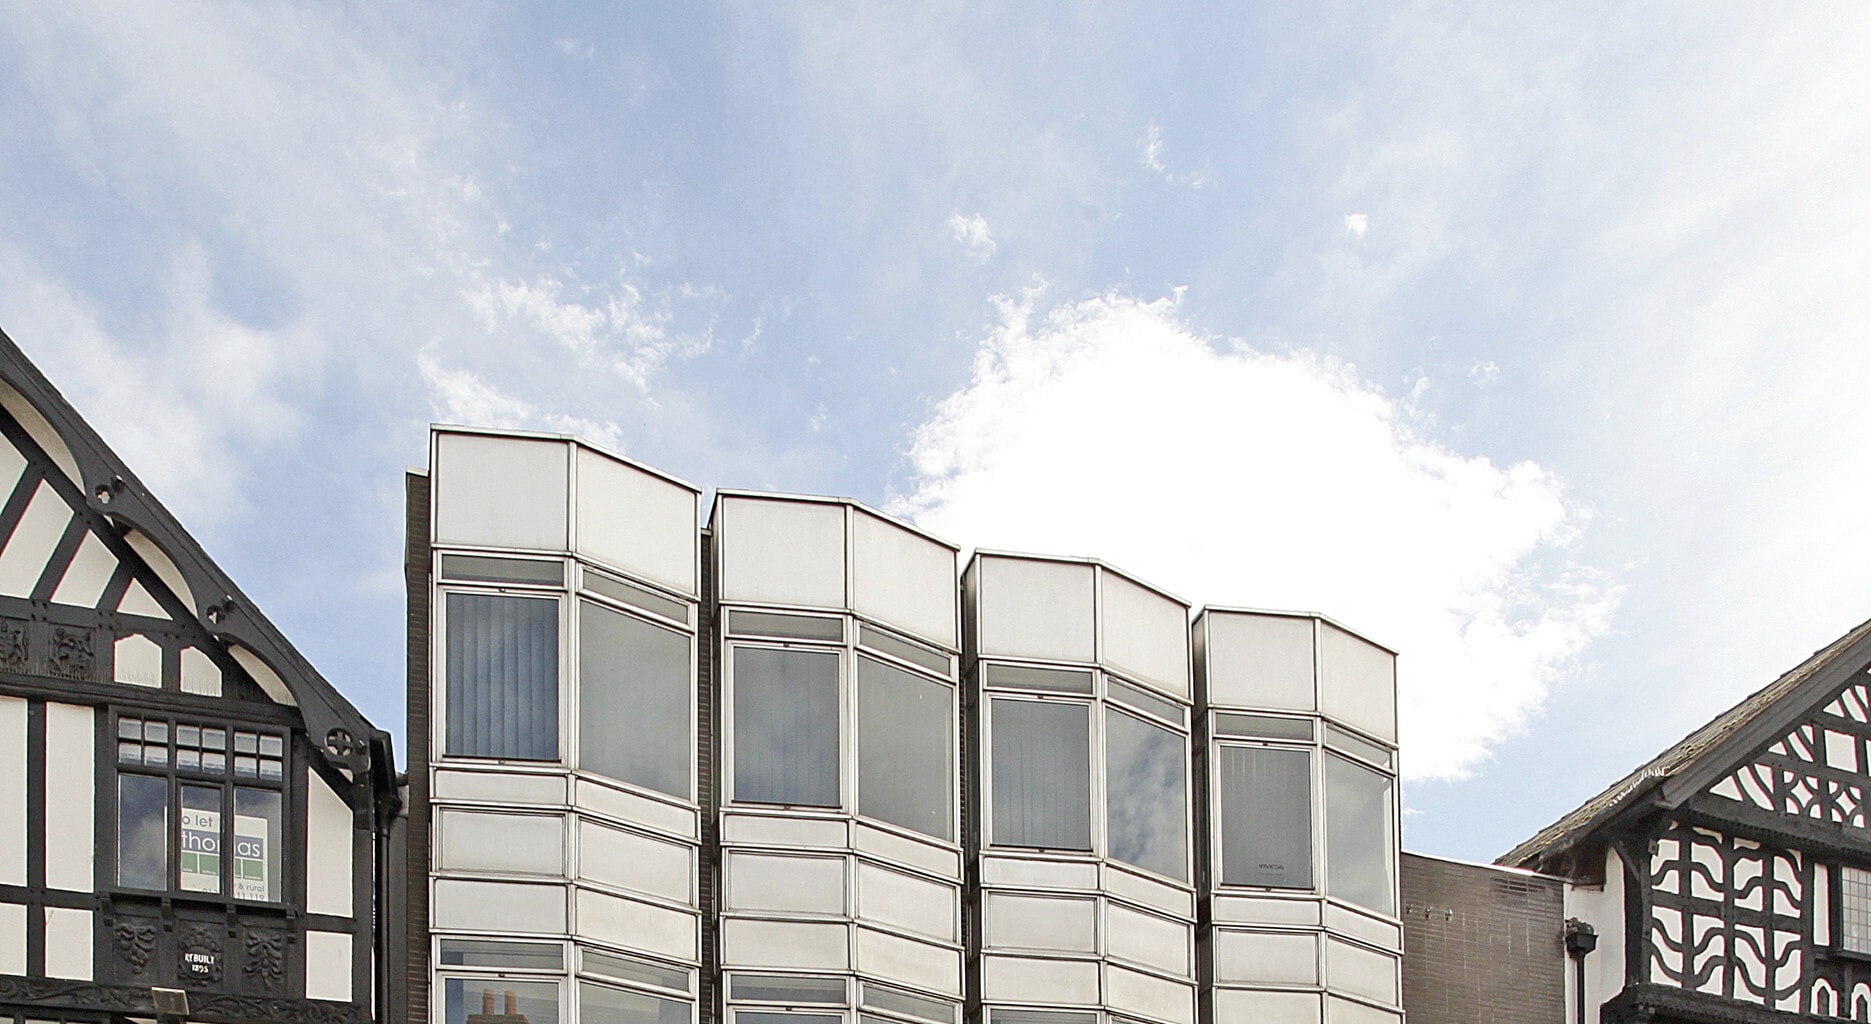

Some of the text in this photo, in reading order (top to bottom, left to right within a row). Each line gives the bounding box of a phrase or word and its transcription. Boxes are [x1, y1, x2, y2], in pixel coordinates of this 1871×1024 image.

[195, 815, 213, 827] let
[182, 831, 261, 858] thoas
[185, 953, 215, 965] REBUILT
